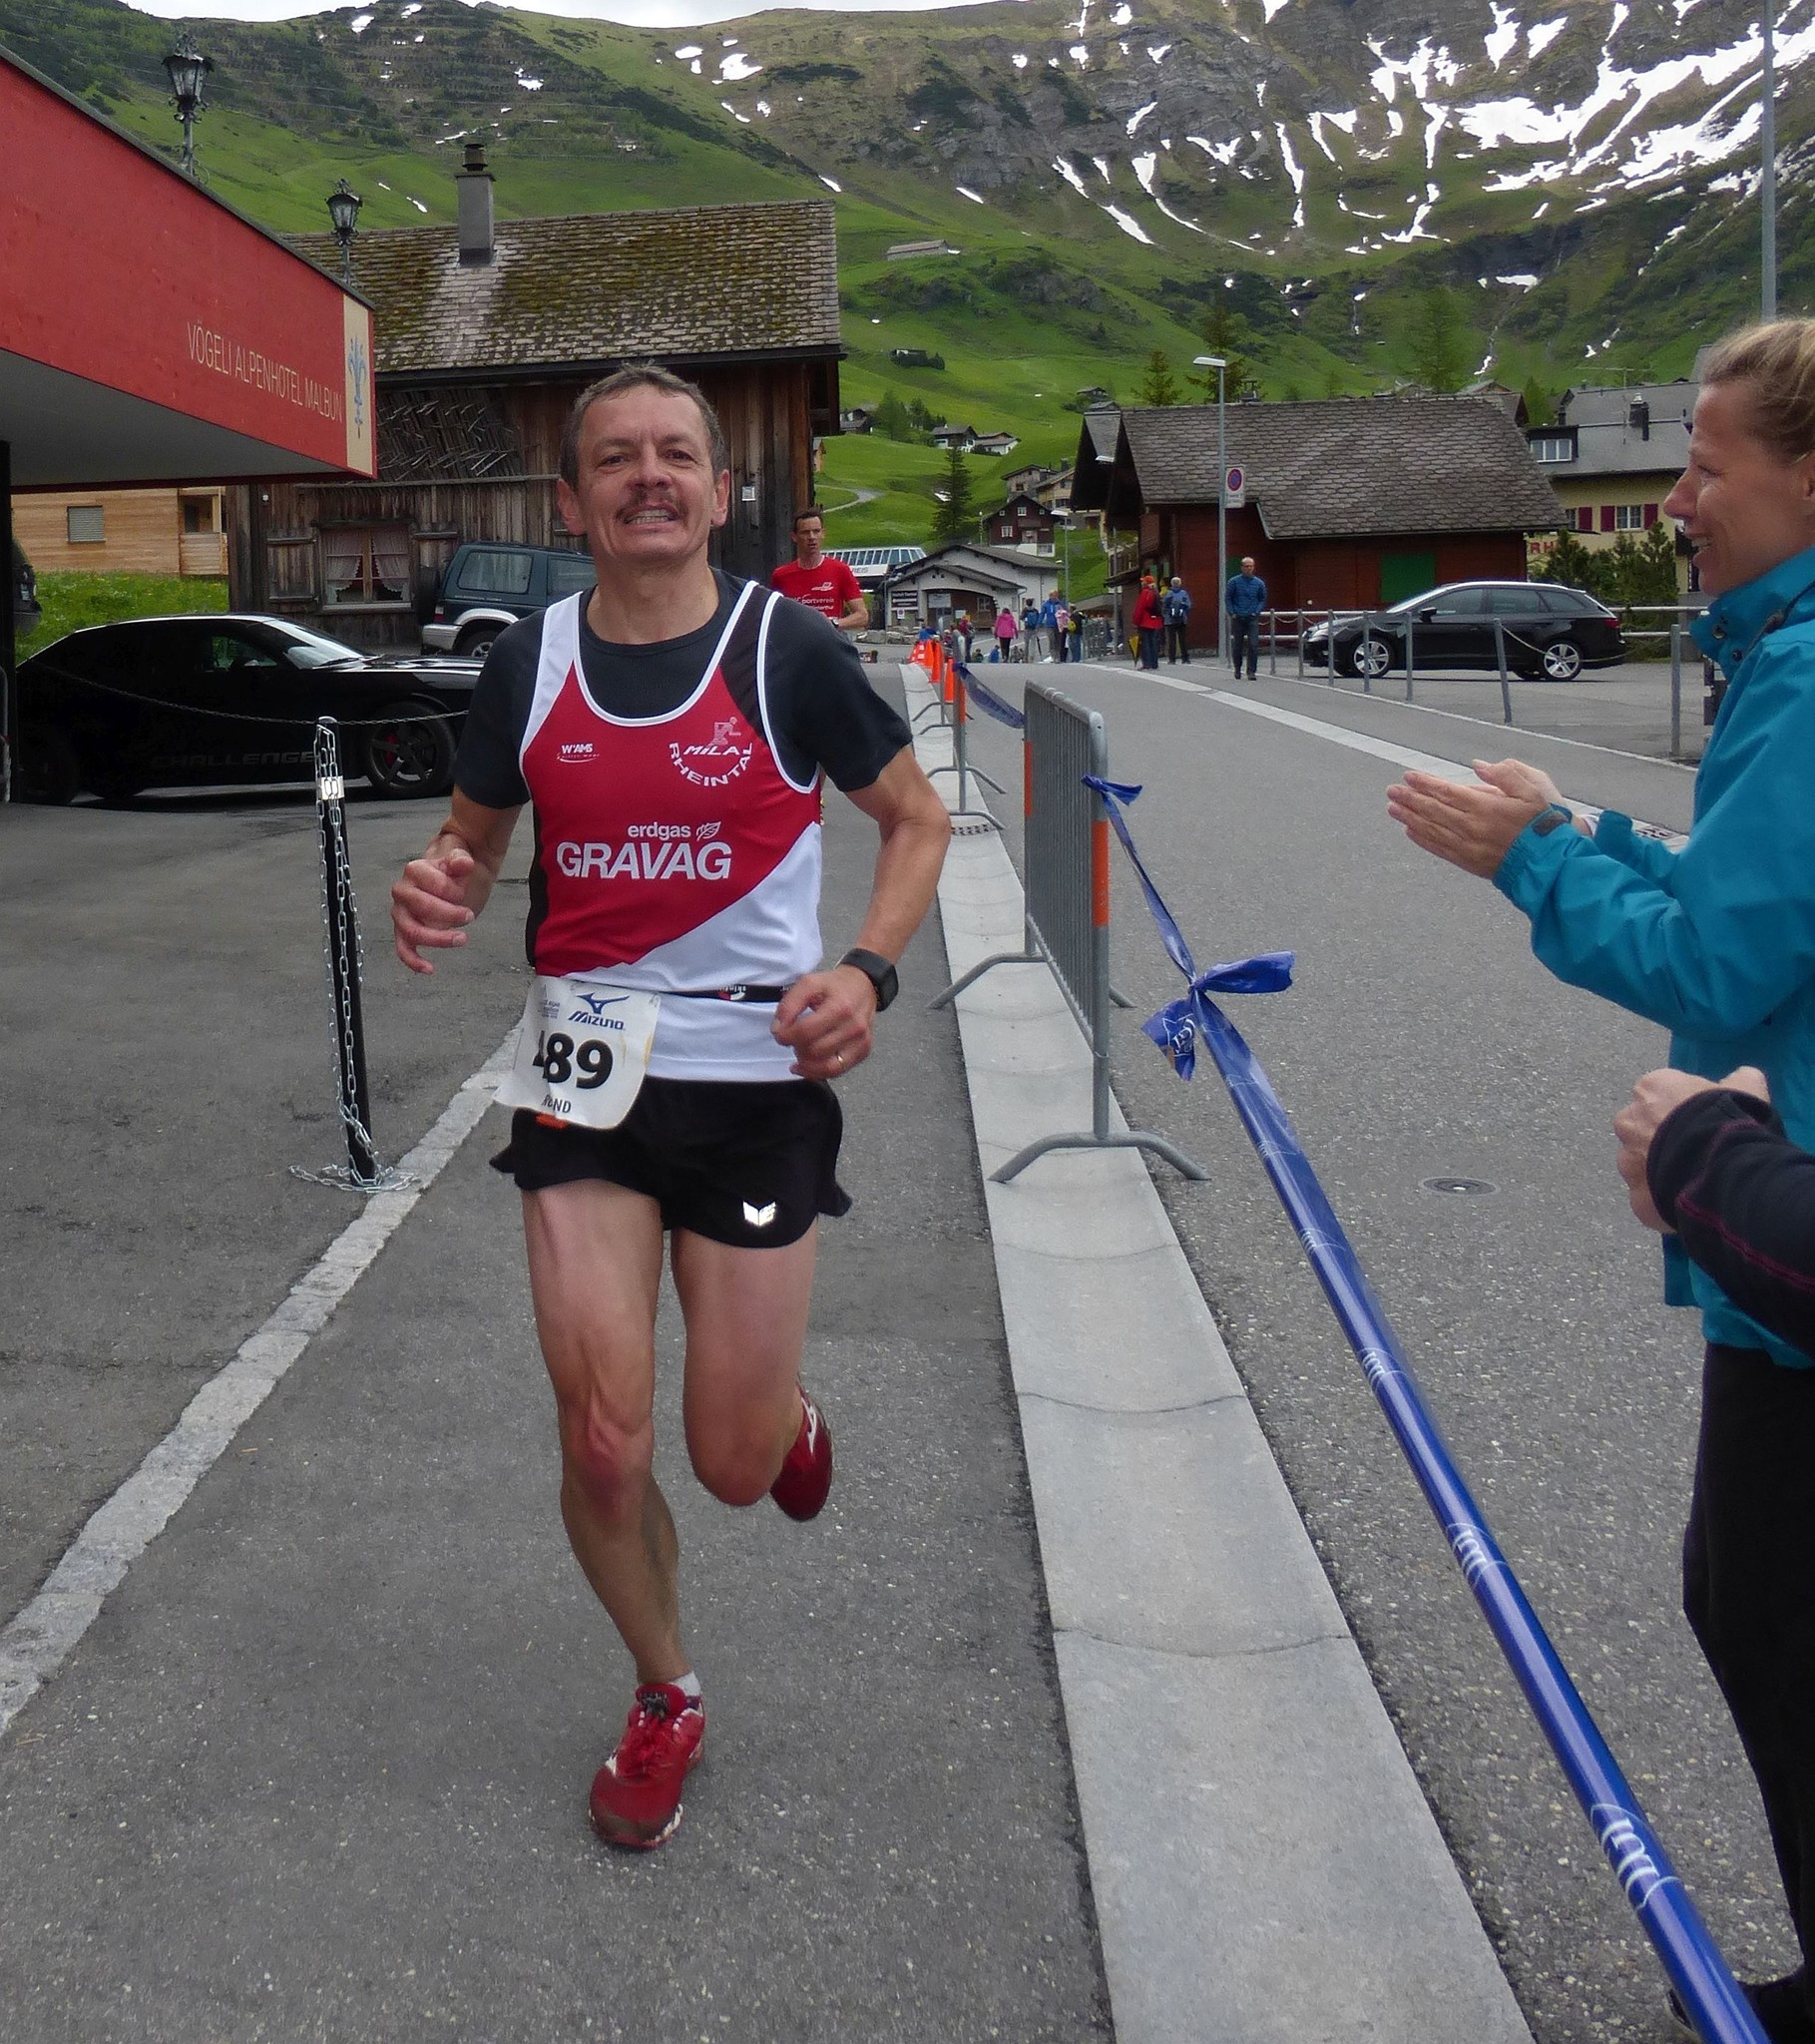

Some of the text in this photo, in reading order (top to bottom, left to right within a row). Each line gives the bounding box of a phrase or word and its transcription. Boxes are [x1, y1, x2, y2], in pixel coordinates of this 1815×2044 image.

[186, 318, 343, 423] VÖGELI ALPENHOTEL MALBUN
[669, 742, 753, 786] RHEINTAL
[628, 821, 690, 839] erdgas
[556, 840, 732, 880] GRAVAG
[567, 1010, 626, 1031] MIZUNO
